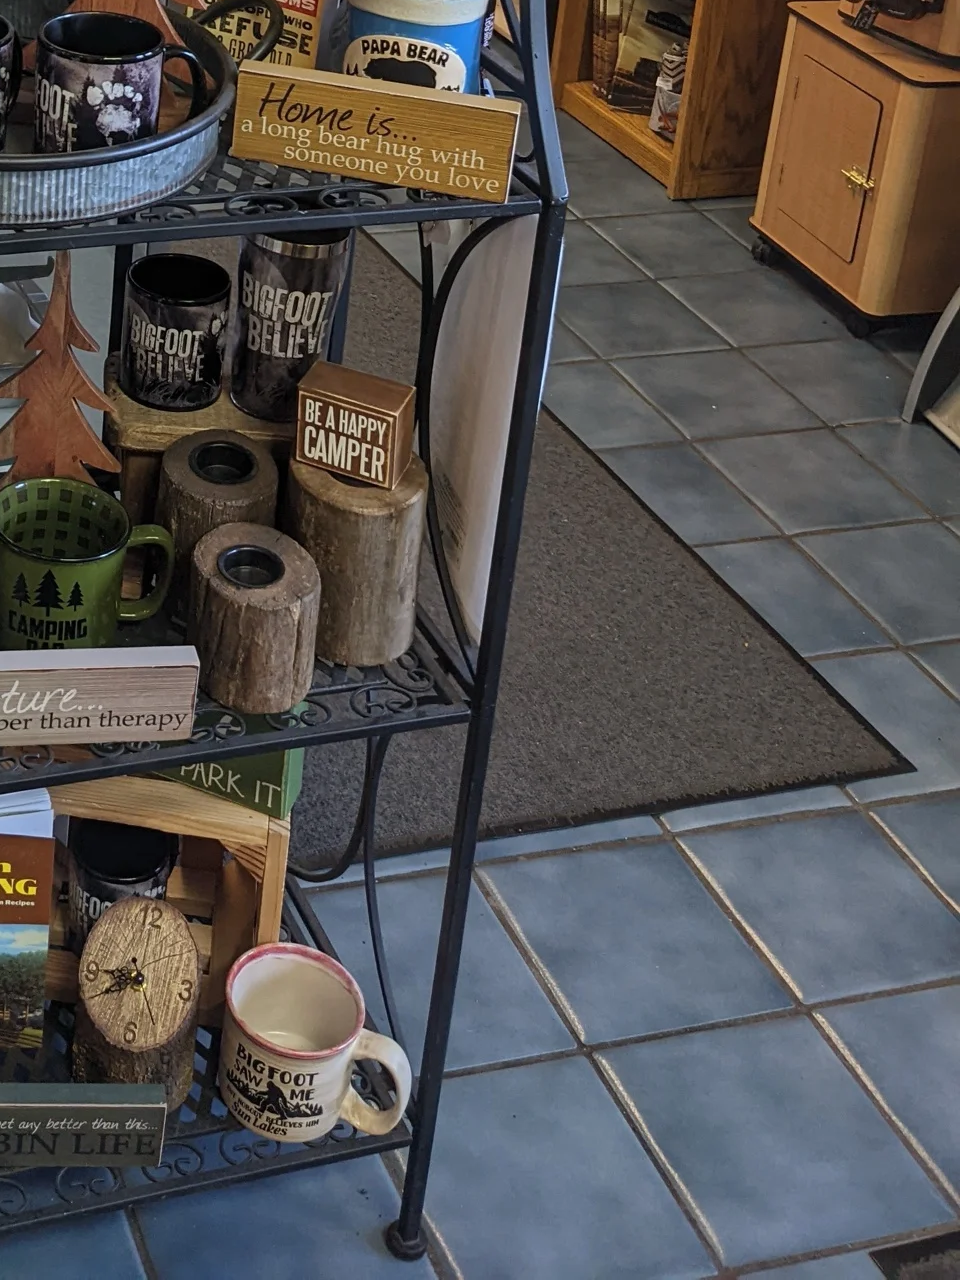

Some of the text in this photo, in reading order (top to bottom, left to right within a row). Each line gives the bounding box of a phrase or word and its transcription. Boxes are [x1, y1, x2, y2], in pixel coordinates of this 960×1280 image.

[361, 39, 449, 67] PAPA BEAR
[258, 82, 353, 133] Home
[241, 118, 485, 170] a long bear hug with
[284, 146, 500, 193] someone you love
[305, 399, 387, 444] BE A HAPPY
[304, 426, 384, 481] CAMPER
[8, 610, 87, 641] CAMPING
[40, 711, 90, 729] than
[99, 710, 189, 731] therapy
[180, 764, 280, 808] PARK IT
[140, 907, 162, 929] 12
[234, 1058, 262, 1087] SAW
[236, 1044, 317, 1086] BIGFOOT
[290, 1088, 314, 1101] ME
